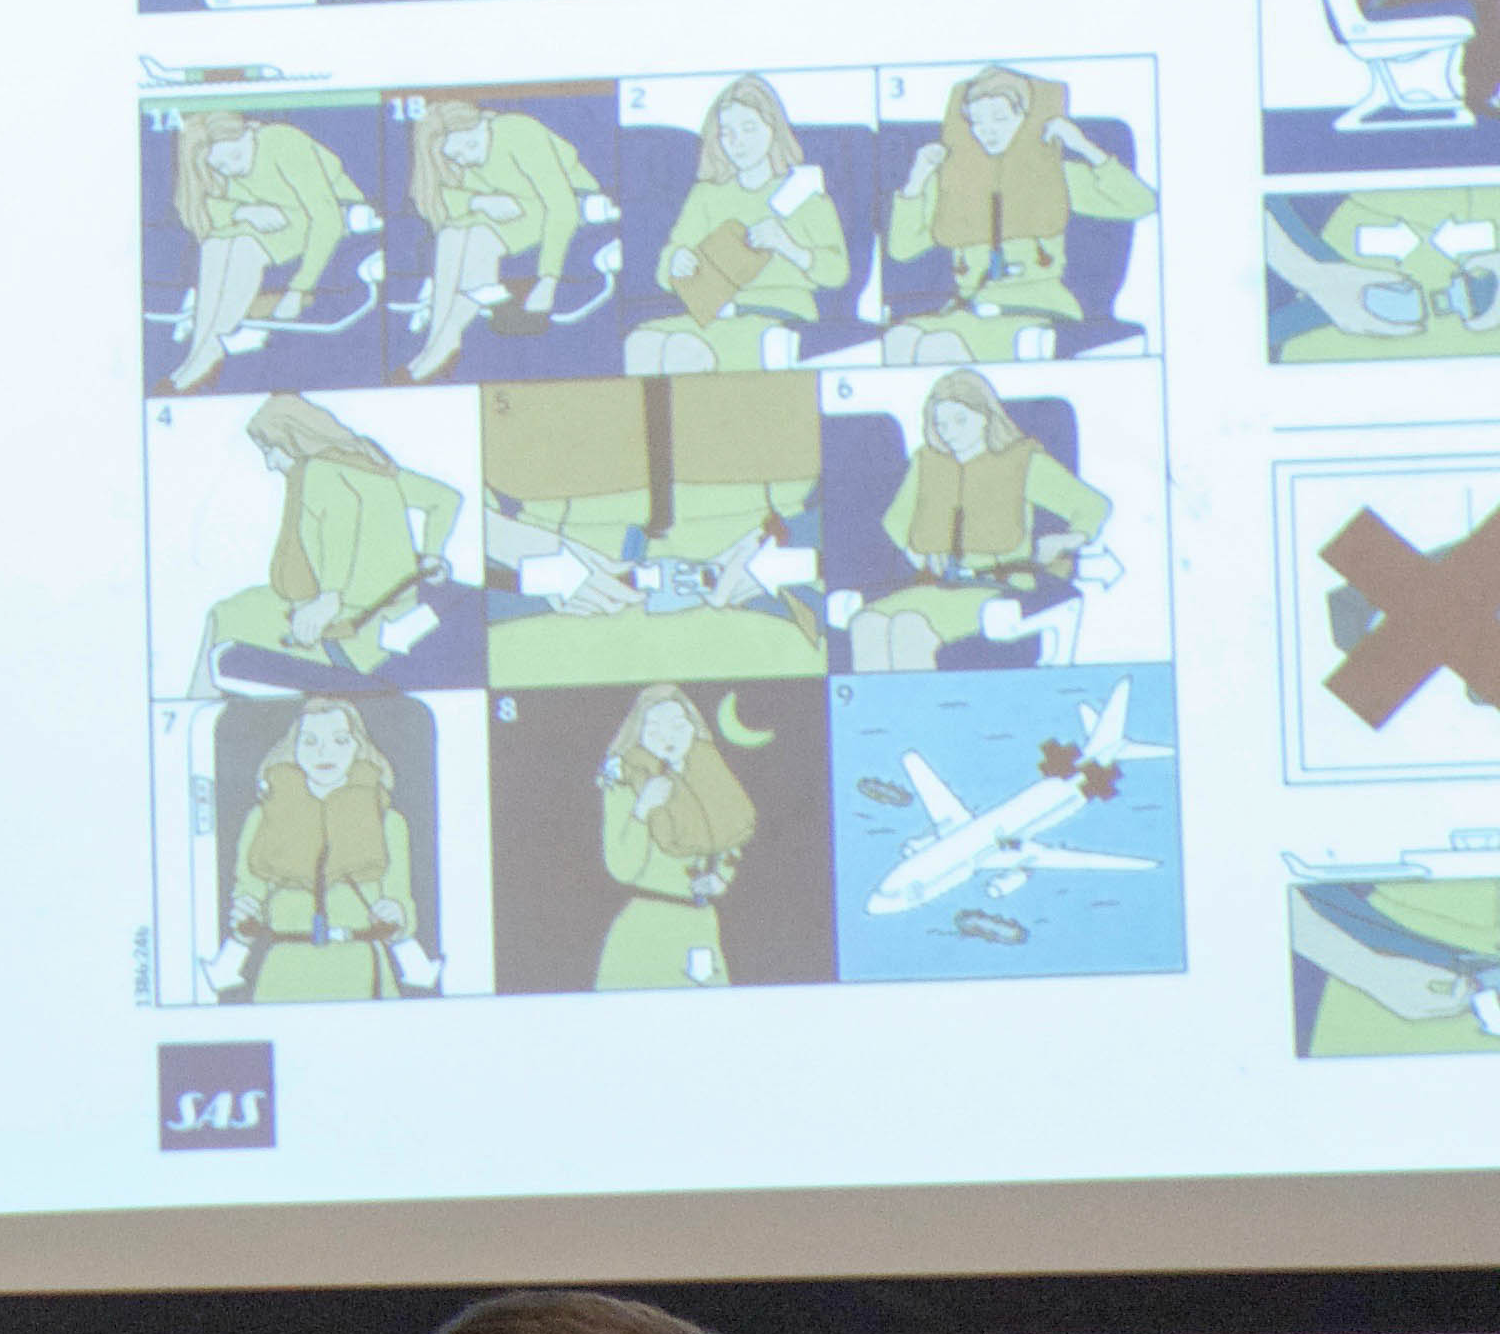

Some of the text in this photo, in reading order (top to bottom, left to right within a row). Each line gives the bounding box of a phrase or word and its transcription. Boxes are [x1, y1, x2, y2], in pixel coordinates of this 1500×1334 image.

[629, 87, 647, 110] 2
[890, 77, 906, 100] 3
[837, 377, 854, 399] 6
[156, 405, 173, 427] 4
[835, 684, 853, 707] 9
[496, 696, 517, 722] 8
[162, 710, 178, 734] 7
[165, 1090, 266, 1131] SAS
